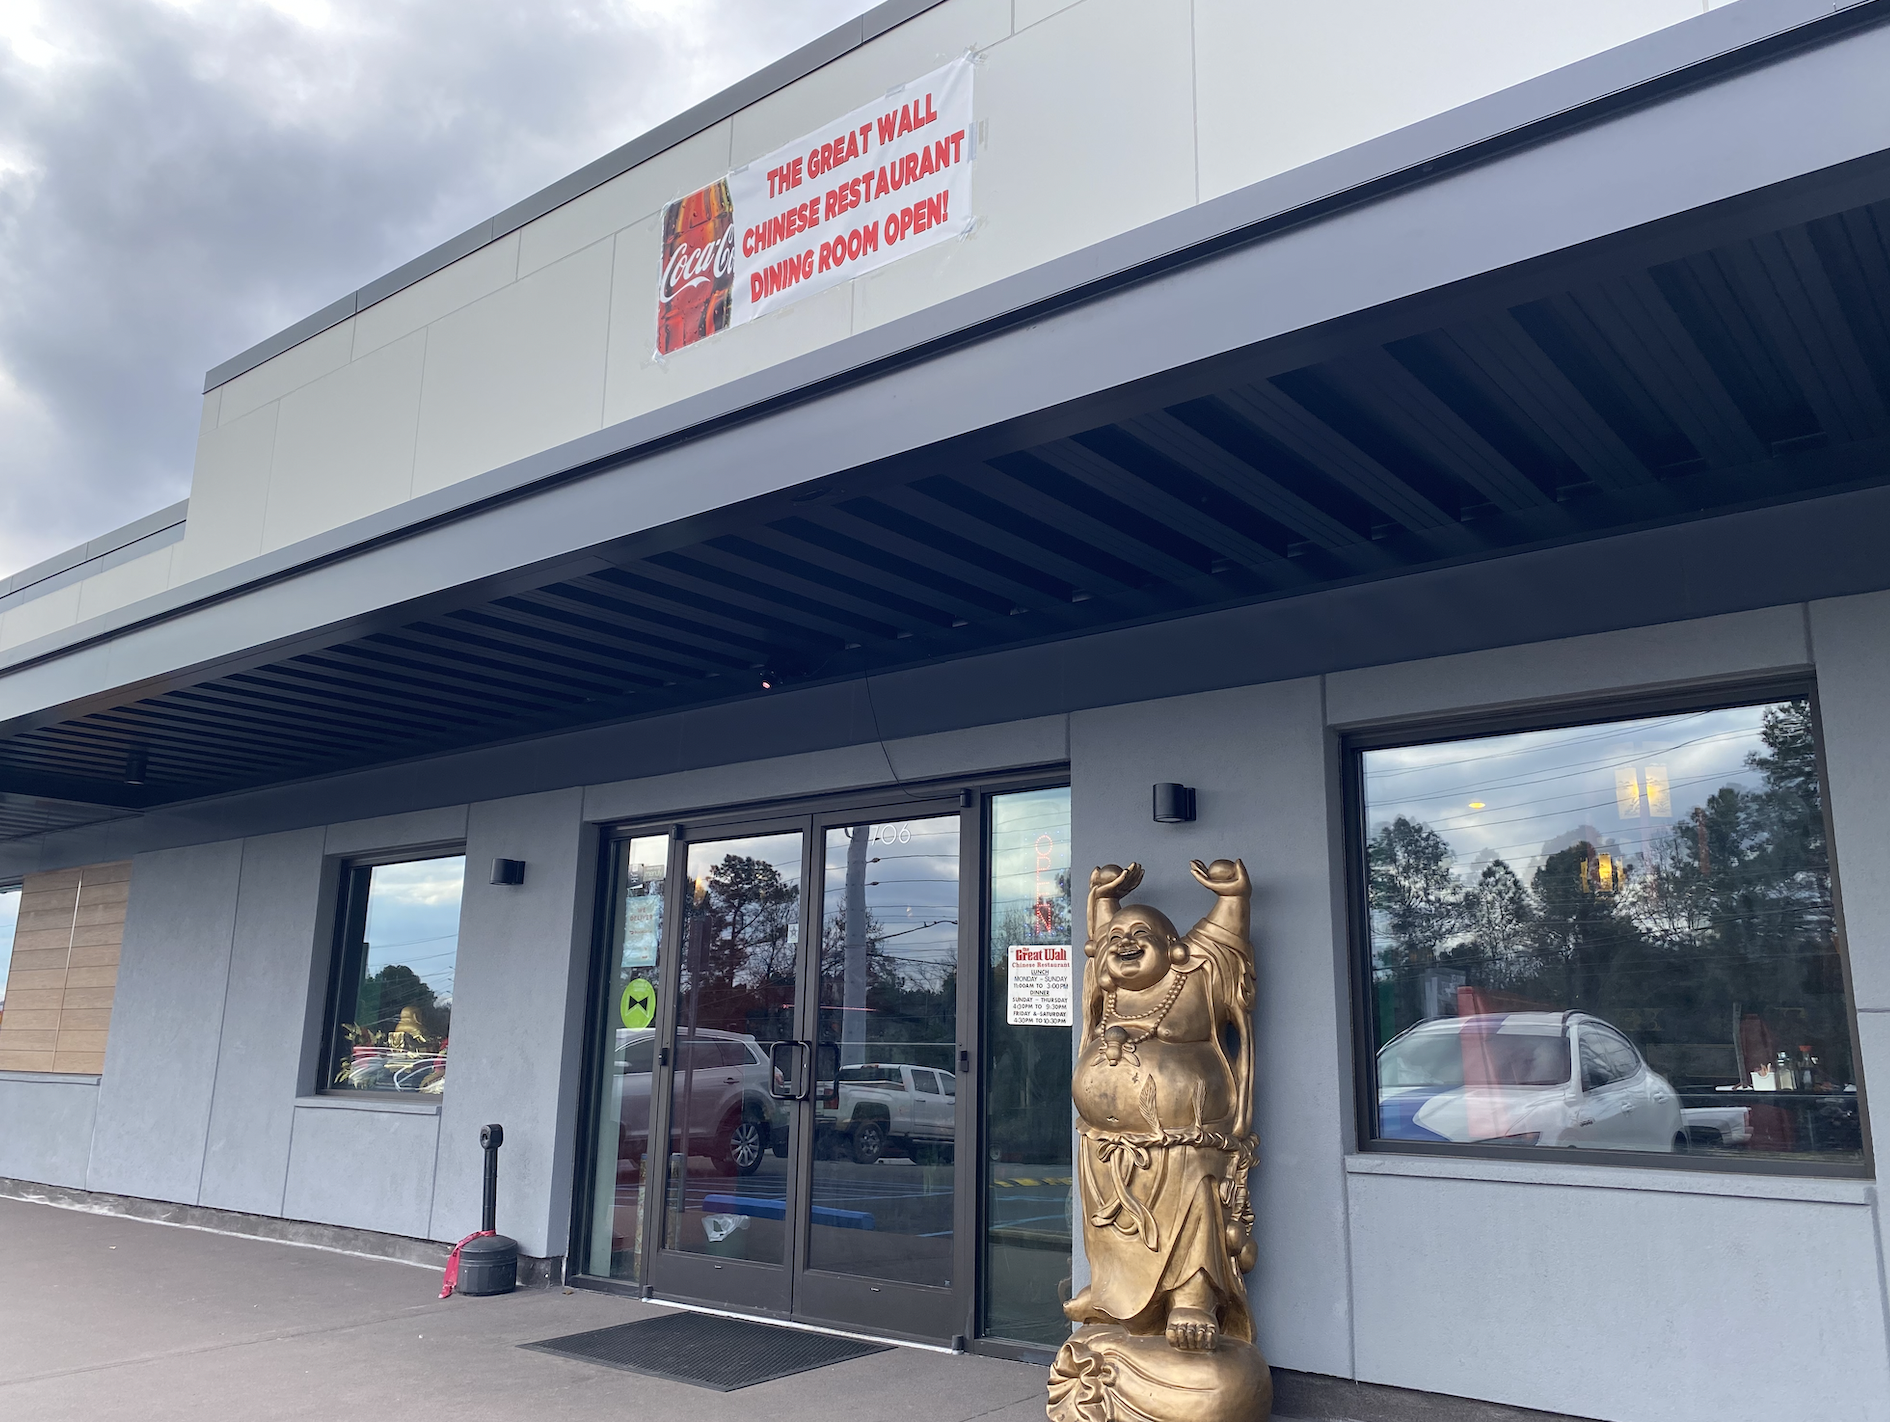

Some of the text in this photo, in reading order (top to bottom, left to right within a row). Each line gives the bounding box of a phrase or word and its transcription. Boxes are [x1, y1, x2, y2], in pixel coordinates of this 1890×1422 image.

[742, 129, 965, 259] CHINESE RESTAURANT
[767, 93, 938, 199] THE GREAT WALL
[750, 190, 950, 304] DINING ROOM OPEN!
[871, 823, 911, 846] 706
[1034, 834, 1053, 935] OPEN
[1015, 948, 1067, 961] Great Wall
